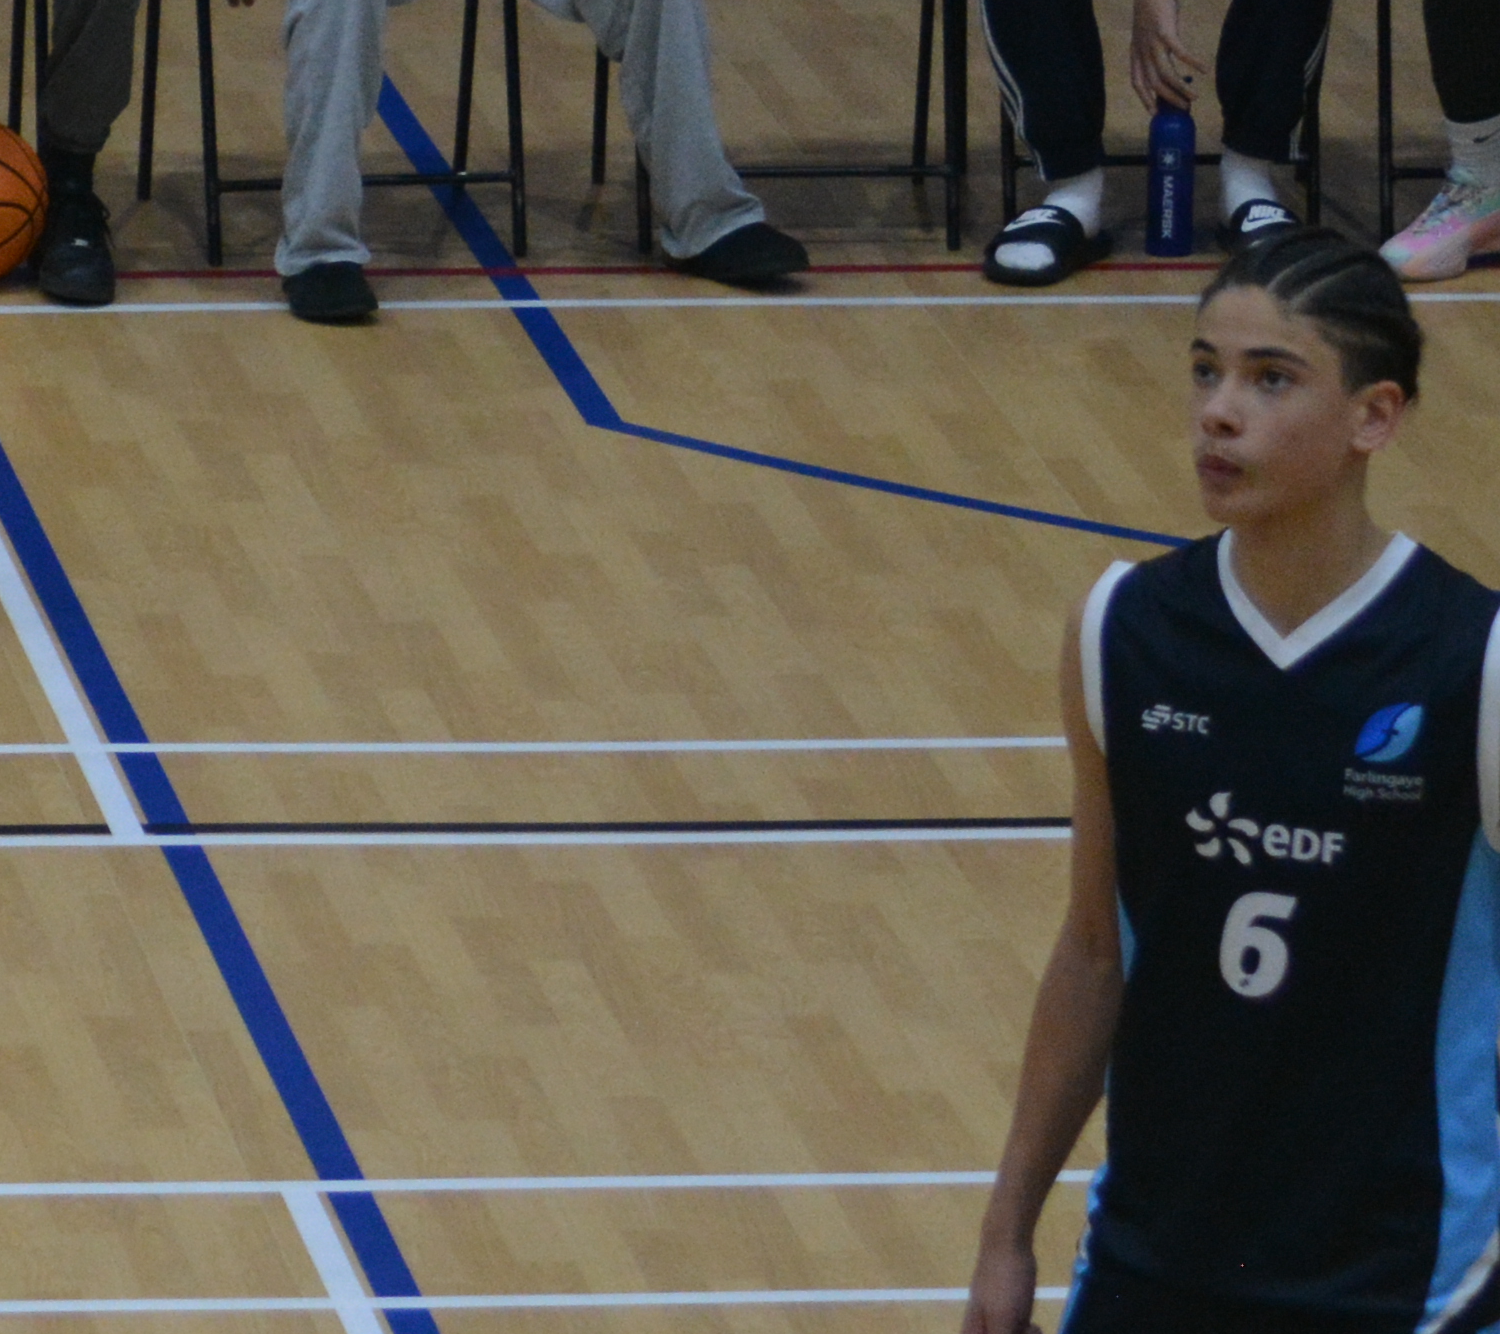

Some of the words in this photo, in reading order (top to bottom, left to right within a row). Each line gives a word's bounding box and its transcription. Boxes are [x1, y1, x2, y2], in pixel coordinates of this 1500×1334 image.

[1160, 174, 1176, 239] MAERSK
[1170, 710, 1210, 735] STC
[1218, 890, 1298, 998] 6
